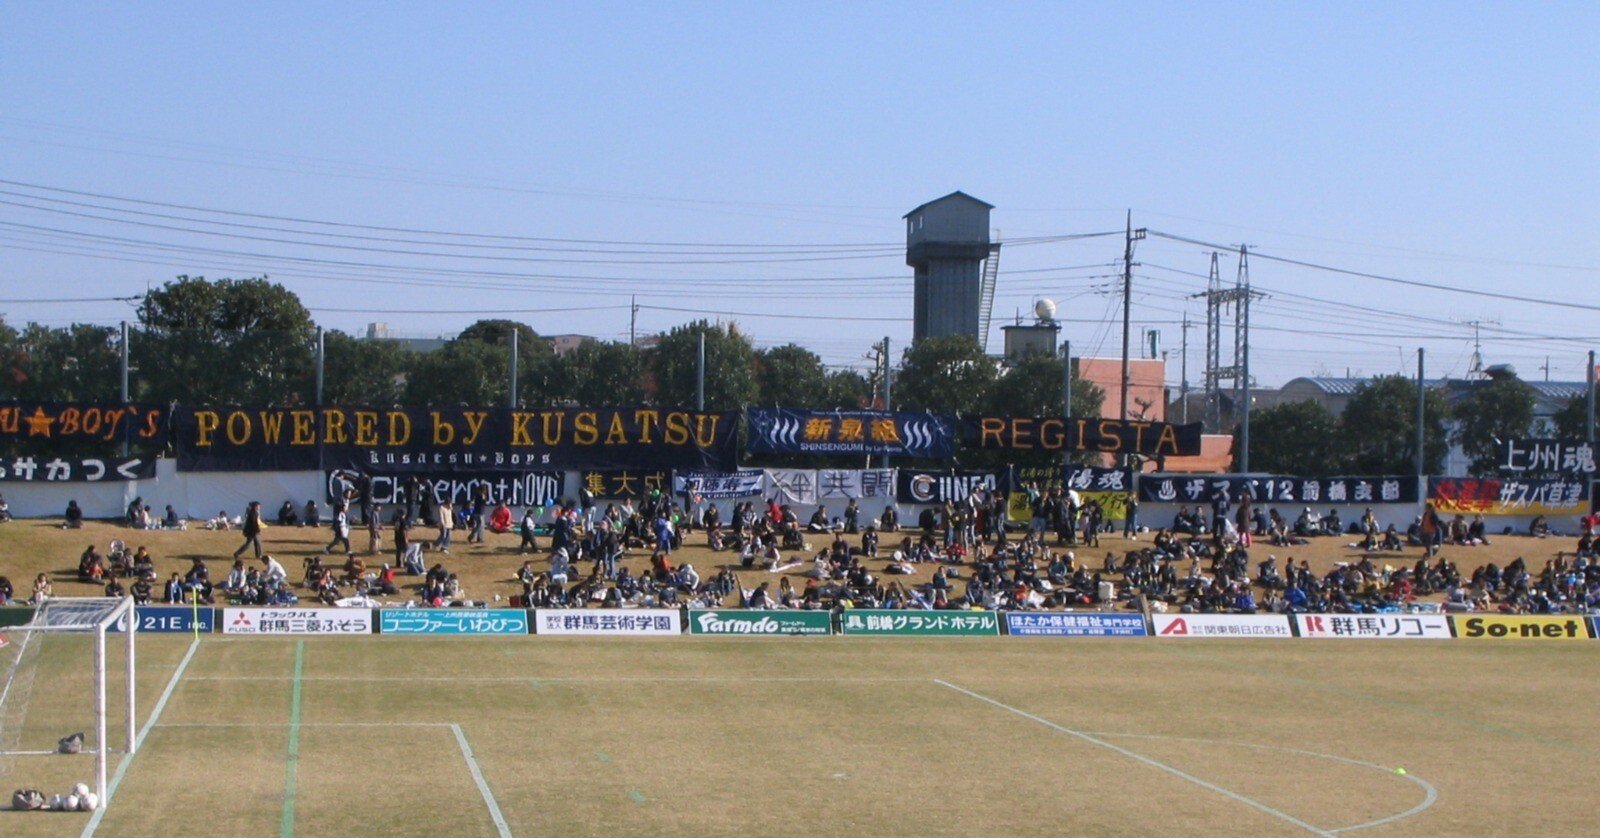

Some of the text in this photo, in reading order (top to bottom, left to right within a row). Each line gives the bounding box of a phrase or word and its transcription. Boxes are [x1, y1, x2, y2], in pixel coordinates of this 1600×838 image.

[194, 409, 720, 447] POWERED by KUSATSU
[803, 417, 901, 442] 新泉組
[981, 418, 1178, 454] REGISTA
[800, 443, 863, 452] SHINSENGUMI
[1500, 439, 1596, 472] 上州魂
[370, 451, 551, 465] Kusatsu Boys
[1500, 480, 1582, 509] ザスパ草津
[144, 616, 181, 629] 21E
[259, 619, 367, 632] 群馬三菱ふそう
[383, 618, 524, 632] コニファーいわびつ
[563, 615, 671, 630] 群馬芸術学園
[698, 612, 778, 633] Farmdo
[866, 615, 994, 631] 前橋グランドホテル
[1204, 624, 1288, 635] 関東朝日広告社
[1331, 617, 1441, 636] 群馬リコー
